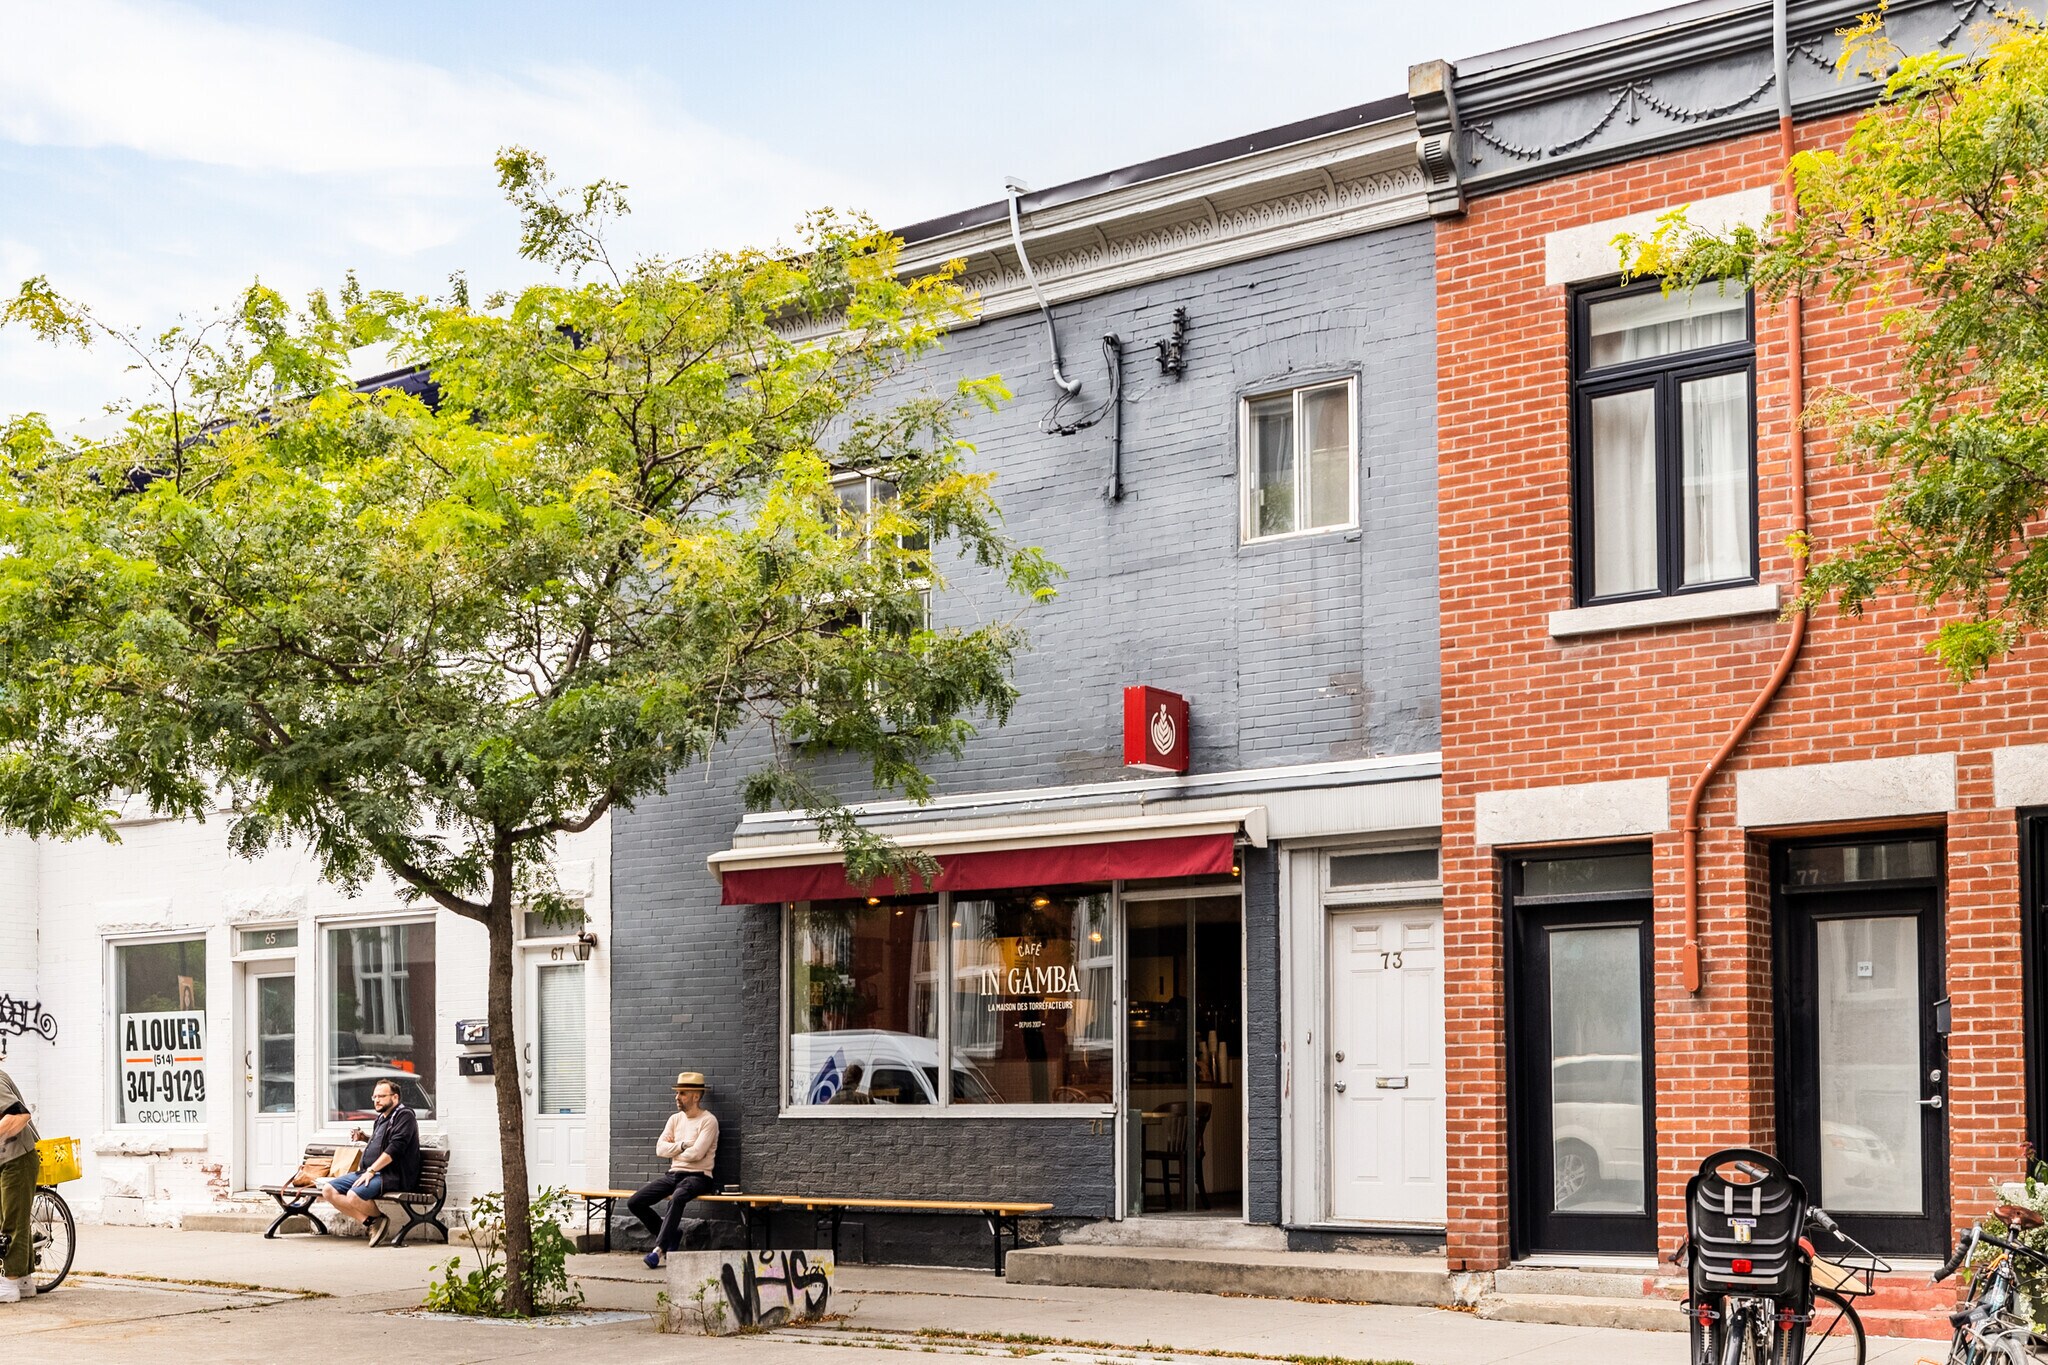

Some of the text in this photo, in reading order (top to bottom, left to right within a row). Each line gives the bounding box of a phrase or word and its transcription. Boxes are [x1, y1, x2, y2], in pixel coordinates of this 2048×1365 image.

[1796, 869, 1819, 885] 77
[265, 932, 276, 945] 65
[551, 946, 564, 961] 67
[1017, 942, 1042, 957] CAFÉ
[1380, 951, 1403, 970] 73
[980, 968, 1001, 996] IN
[1007, 964, 1081, 995] GAMBA
[987, 1000, 1073, 1012] LA MAISON DES TORRÉFACTEURS
[126, 1015, 202, 1051] À LOUER
[153, 1054, 174, 1067] (514)
[126, 1069, 206, 1103] 347-9129
[138, 1109, 199, 1123] GROUPE ITR
[1090, 1119, 1103, 1135] 71
